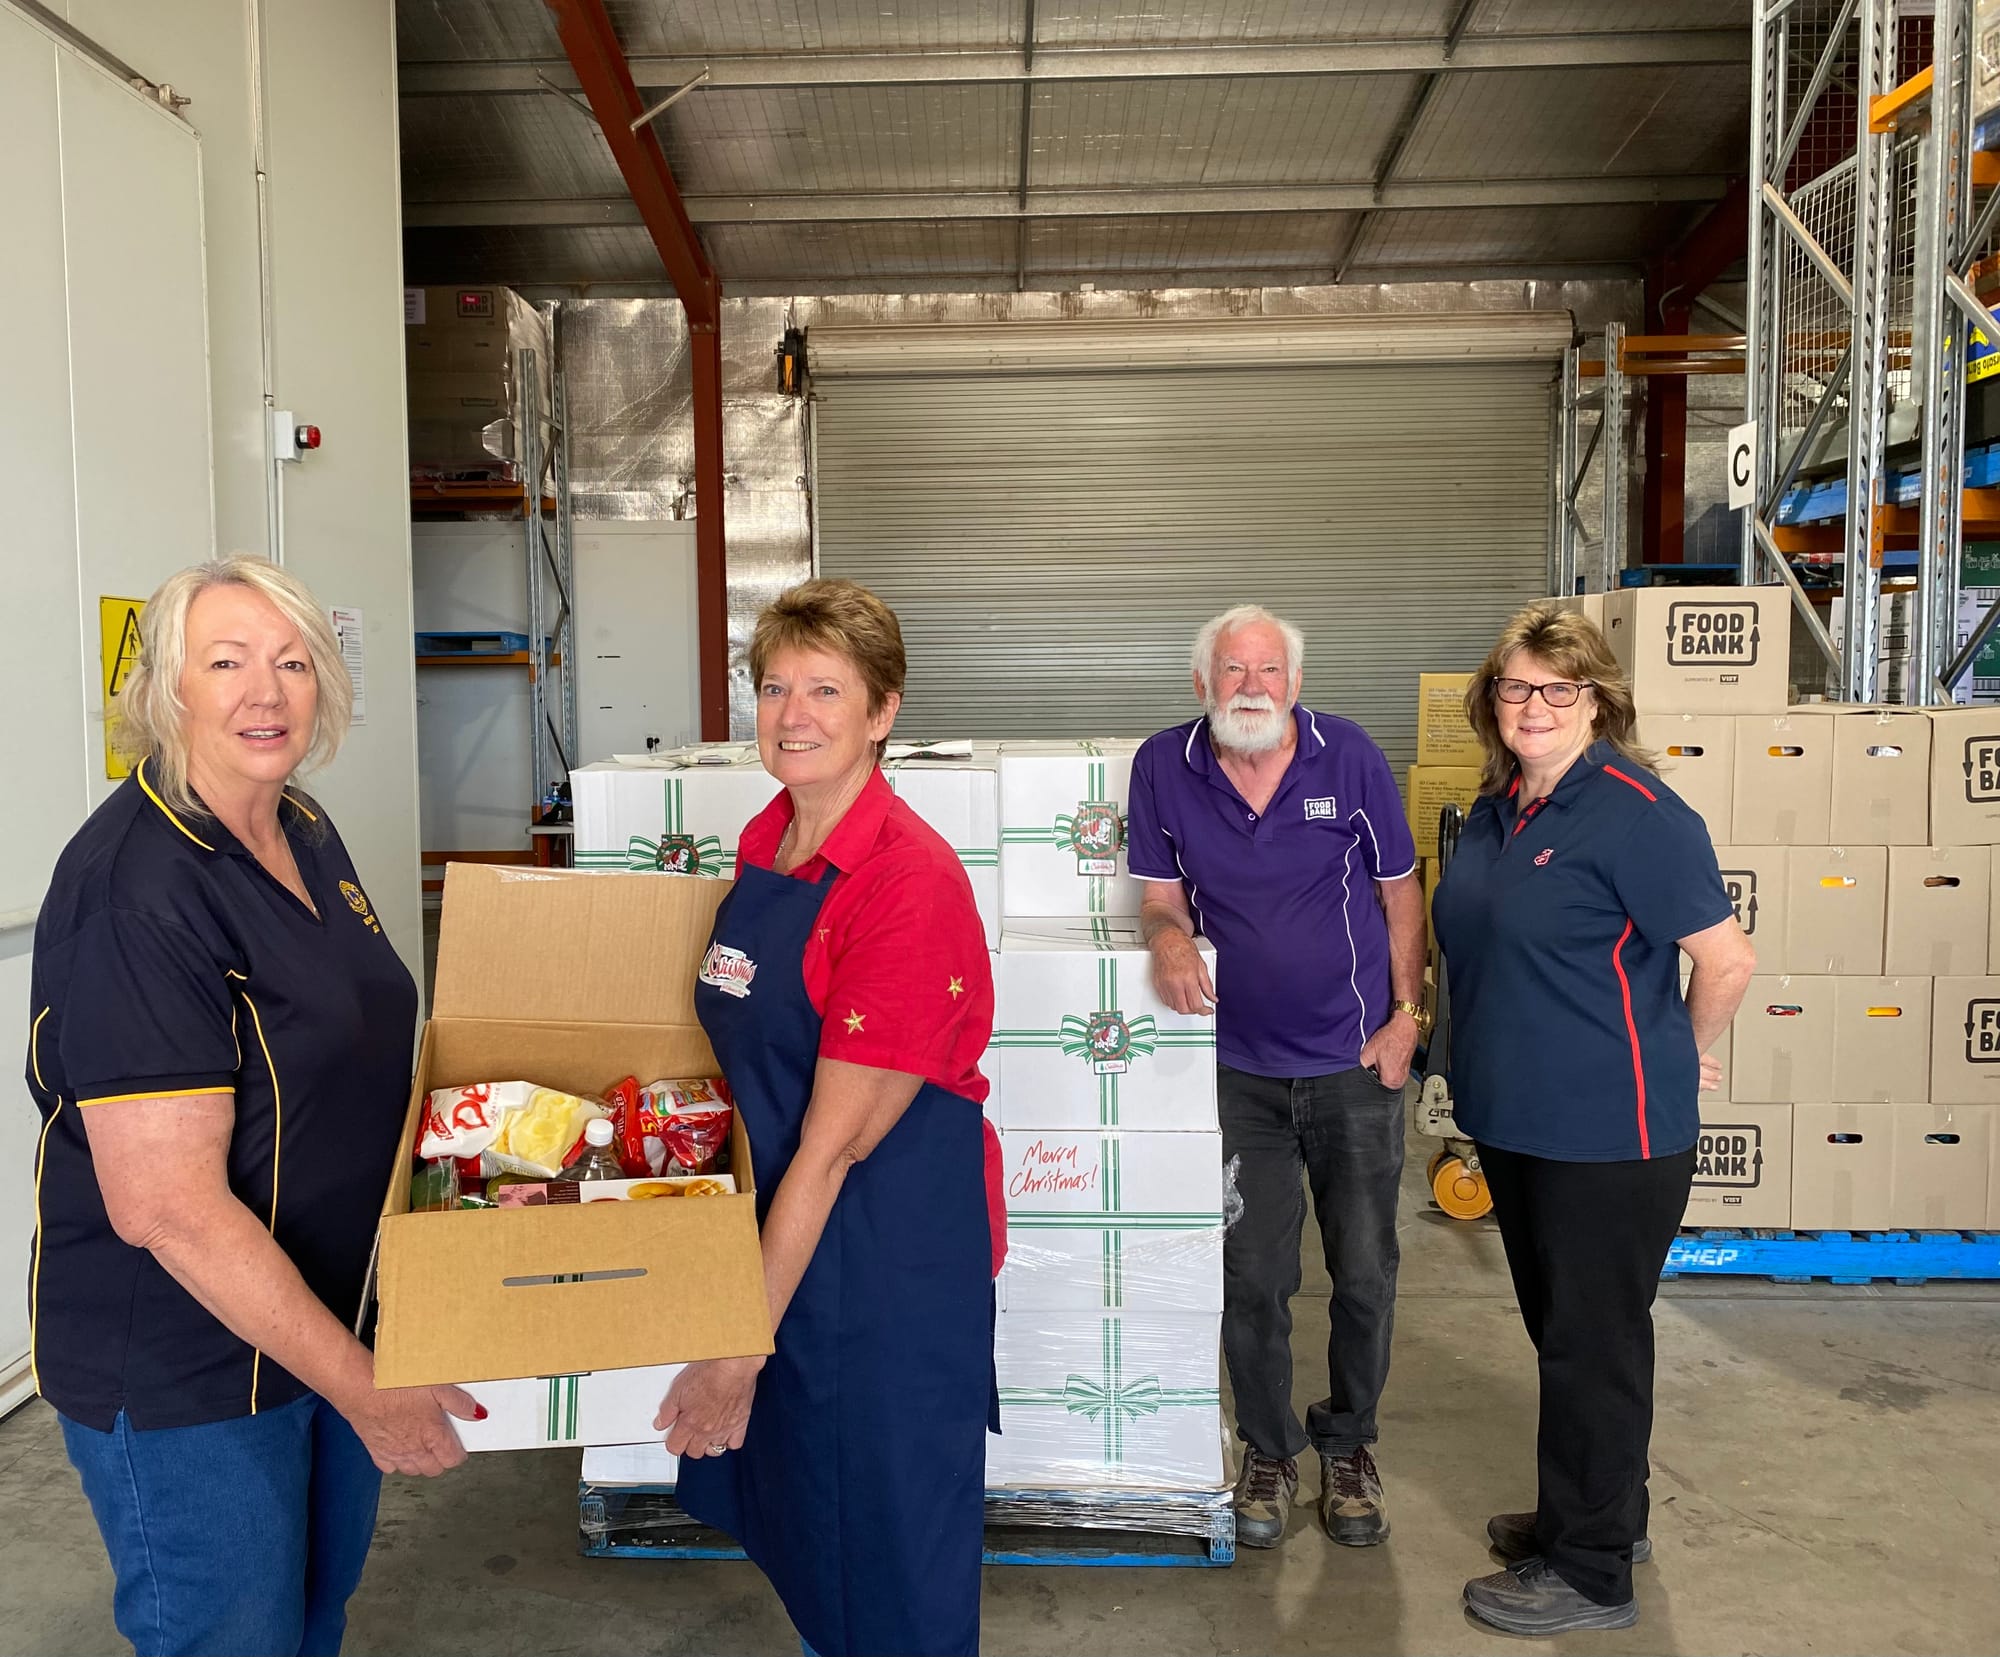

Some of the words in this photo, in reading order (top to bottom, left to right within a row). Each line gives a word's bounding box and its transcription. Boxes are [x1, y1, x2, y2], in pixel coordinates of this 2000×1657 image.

[1733, 443, 1750, 487] C
[1682, 613, 1744, 633] FOOD
[1681, 635, 1744, 655] BANK
[1308, 801, 1331, 810] FOOD
[1309, 808, 1332, 816] BANK
[1022, 1139, 1078, 1169] Merry
[1698, 1135, 1747, 1156] OOD
[1697, 1156, 1747, 1177] ANK
[1009, 1163, 1098, 1198] Christmas!
[1667, 1247, 1739, 1266] CHEP
